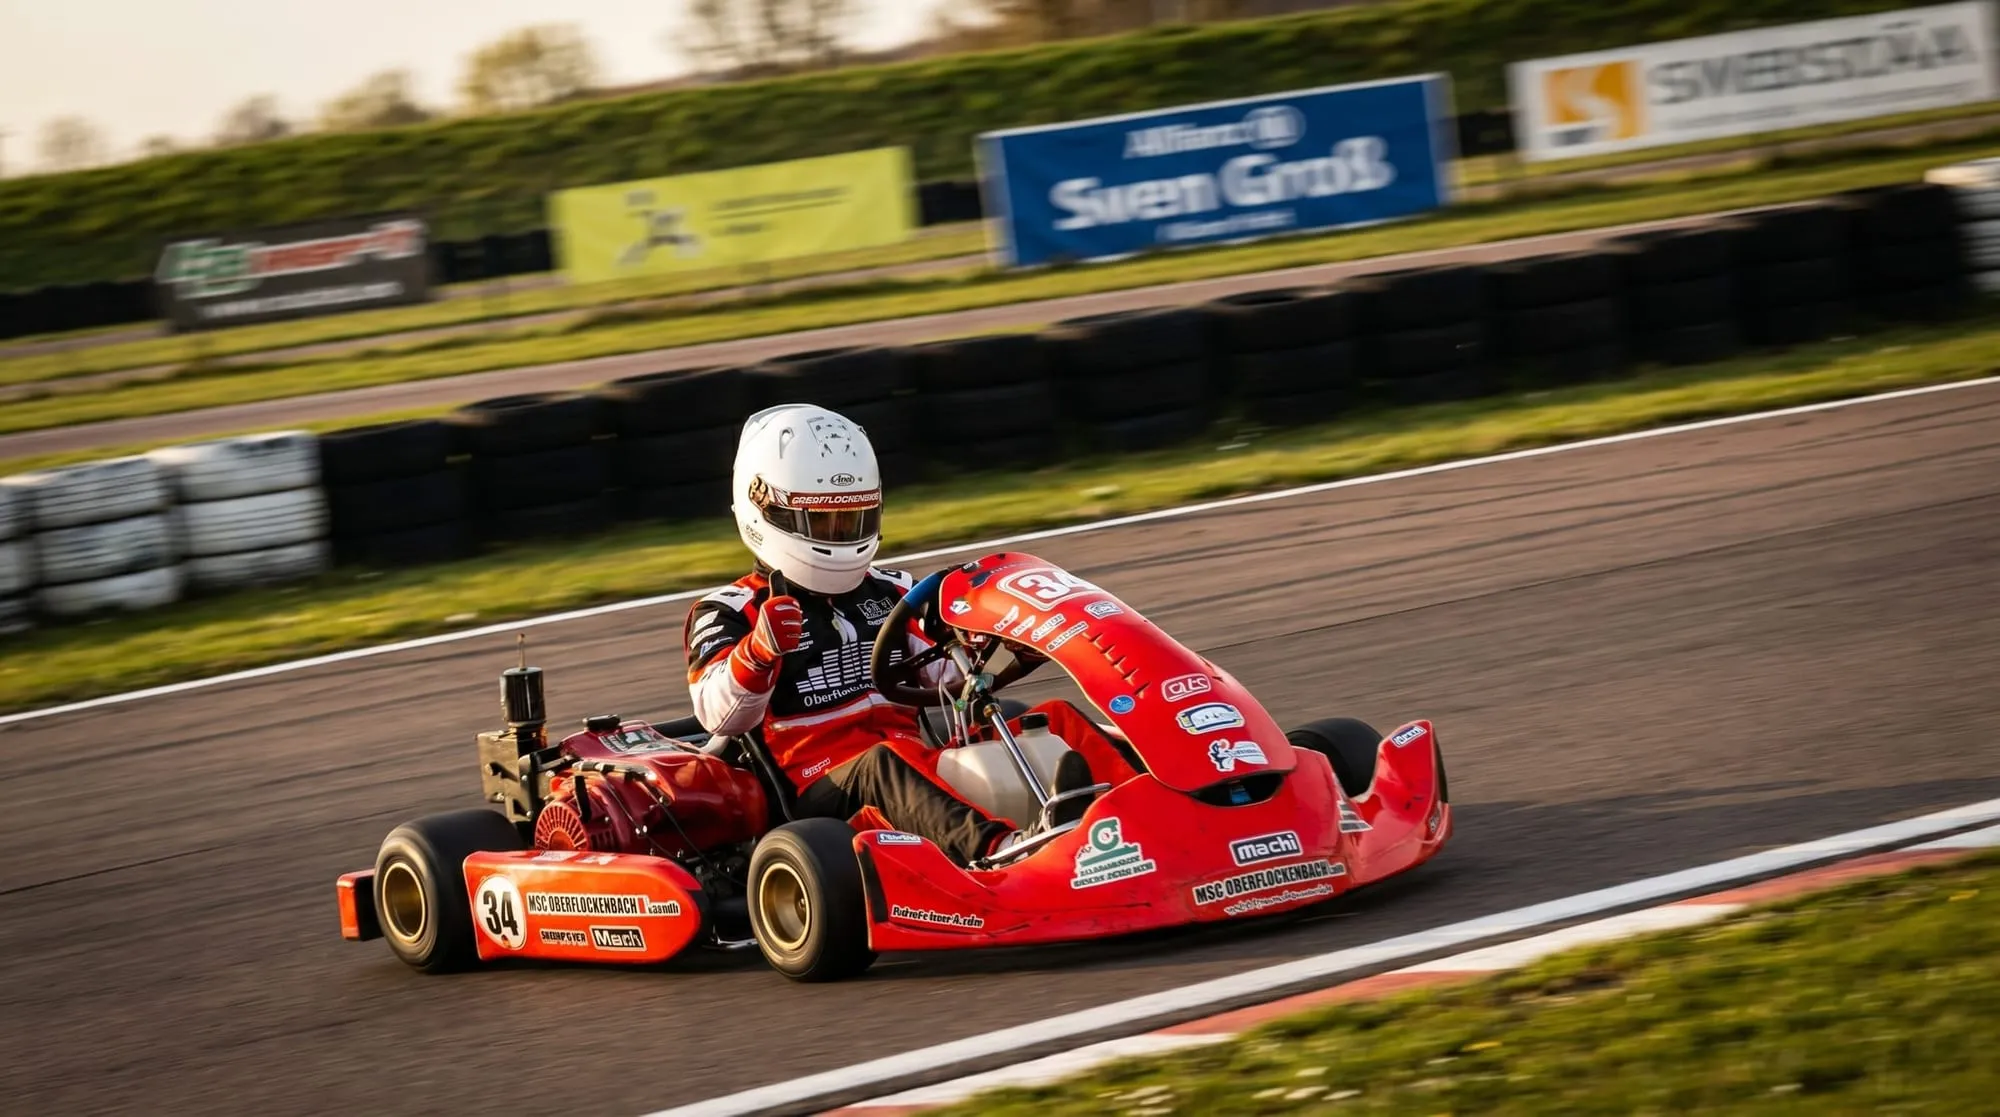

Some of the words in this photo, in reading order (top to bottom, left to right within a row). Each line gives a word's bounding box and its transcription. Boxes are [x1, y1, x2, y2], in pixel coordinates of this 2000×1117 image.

[1048, 172, 1221, 230] Sven
[1237, 834, 1298, 860] machi
[1194, 883, 1224, 903] MSC
[1225, 861, 1329, 894] OBERFLOCKENBACH
[483, 890, 519, 936] 34
[528, 895, 548, 912] MSC
[549, 896, 638, 914] OBERFLOCKENBACH
